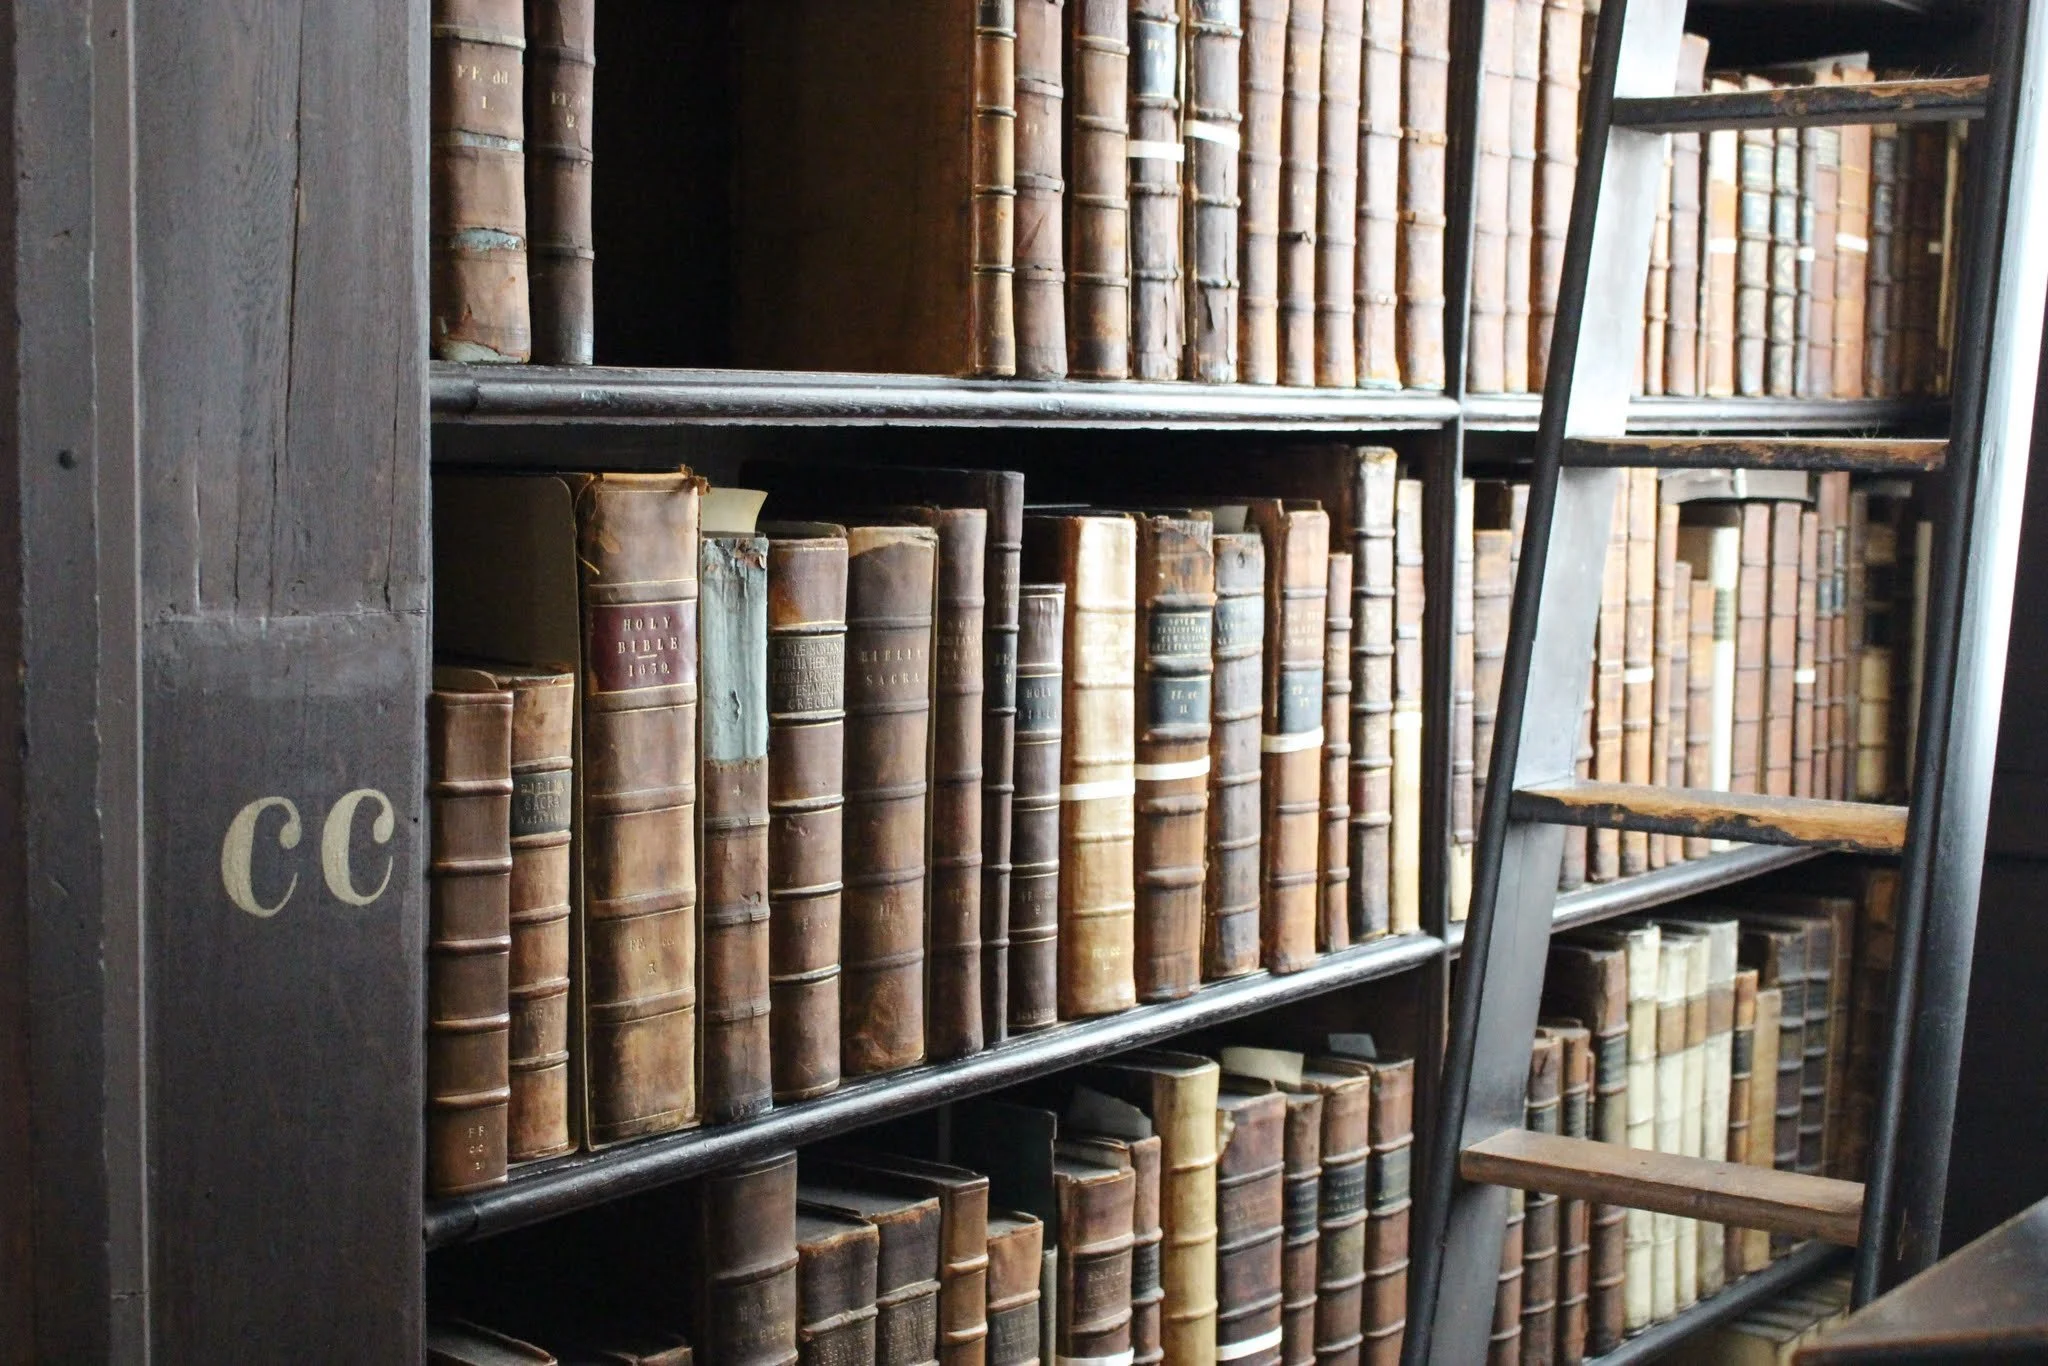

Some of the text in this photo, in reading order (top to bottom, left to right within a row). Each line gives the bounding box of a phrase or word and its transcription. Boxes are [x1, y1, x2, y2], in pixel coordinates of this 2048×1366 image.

[623, 616, 671, 632] HOLY
[617, 636, 678, 654] BIBLE
[468, 1125, 485, 1138] FF
